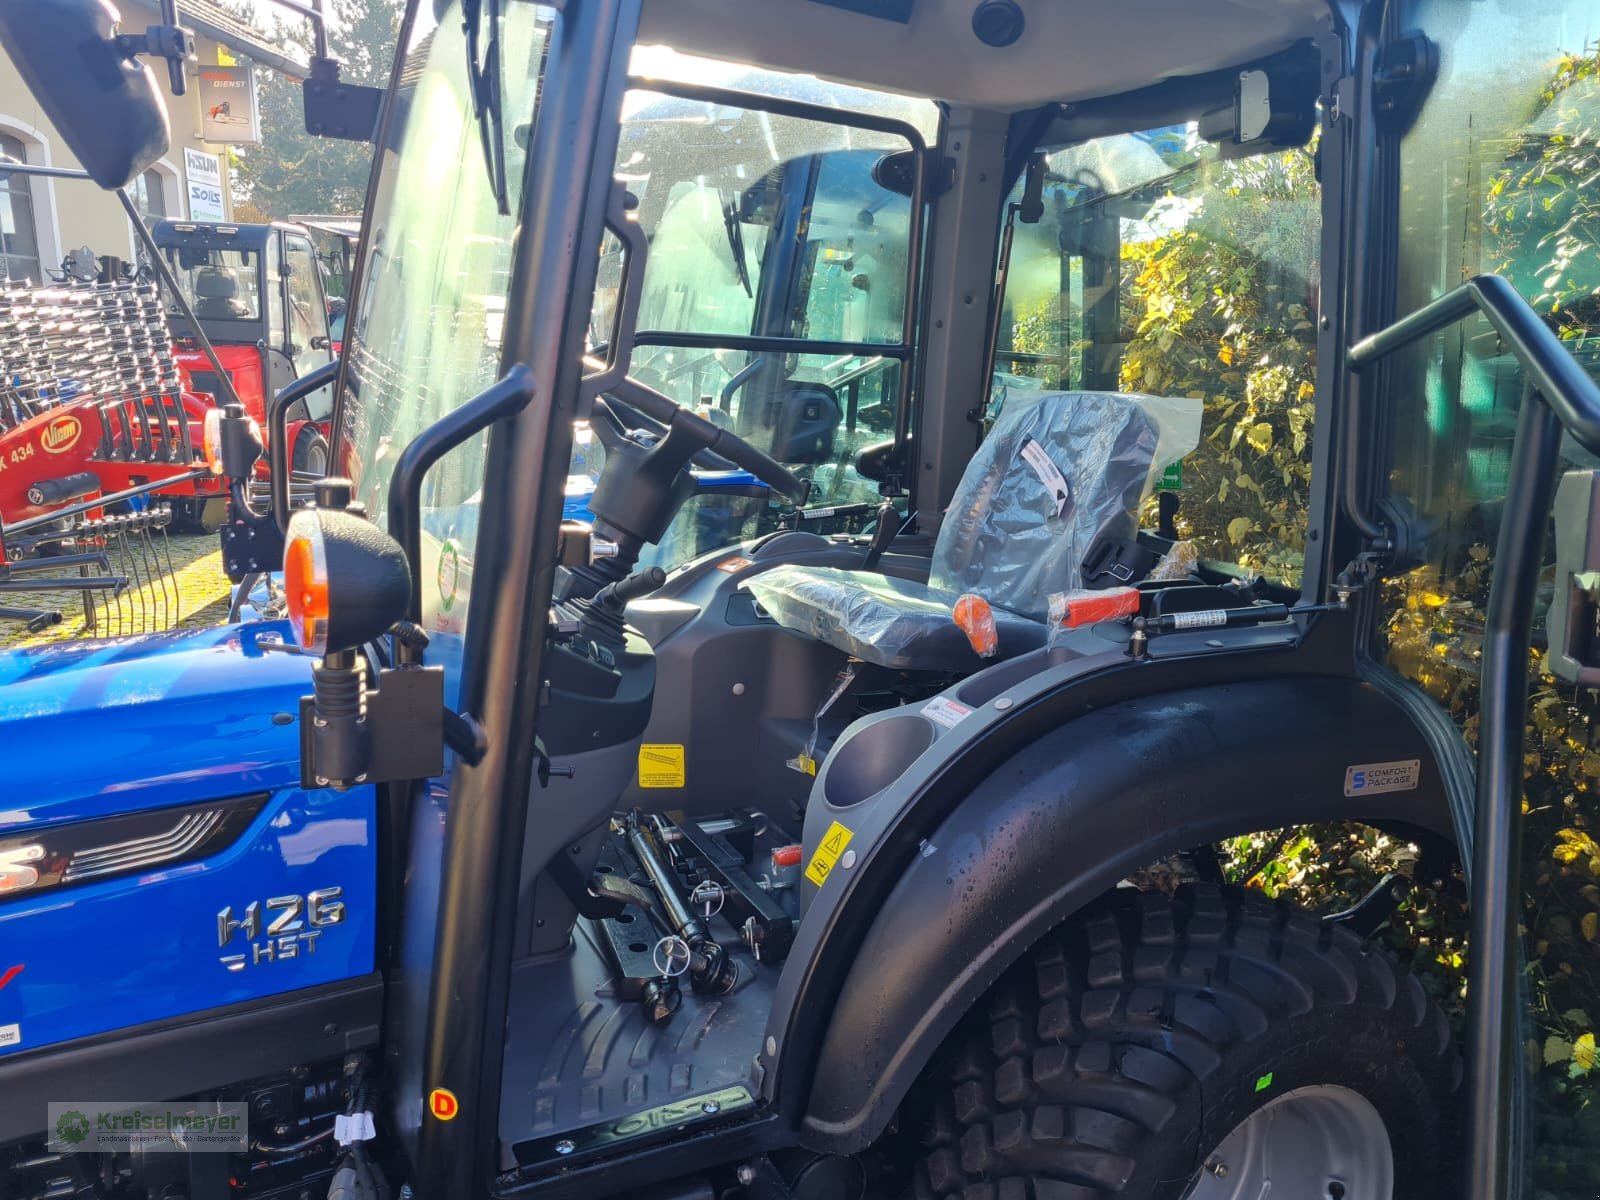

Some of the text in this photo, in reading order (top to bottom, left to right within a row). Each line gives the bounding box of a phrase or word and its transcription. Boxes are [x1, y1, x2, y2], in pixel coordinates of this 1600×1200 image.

[213, 80, 246, 88] DIENST
[187, 152, 218, 174] HSUN
[43, 419, 78, 448] Vicon
[11, 441, 35, 463] 434
[1367, 775, 1412, 787] PACKAGE
[1368, 766, 1413, 778] COMFORT
[217, 886, 346, 948] H26
[252, 929, 323, 966] HST
[434, 1091, 455, 1117] D
